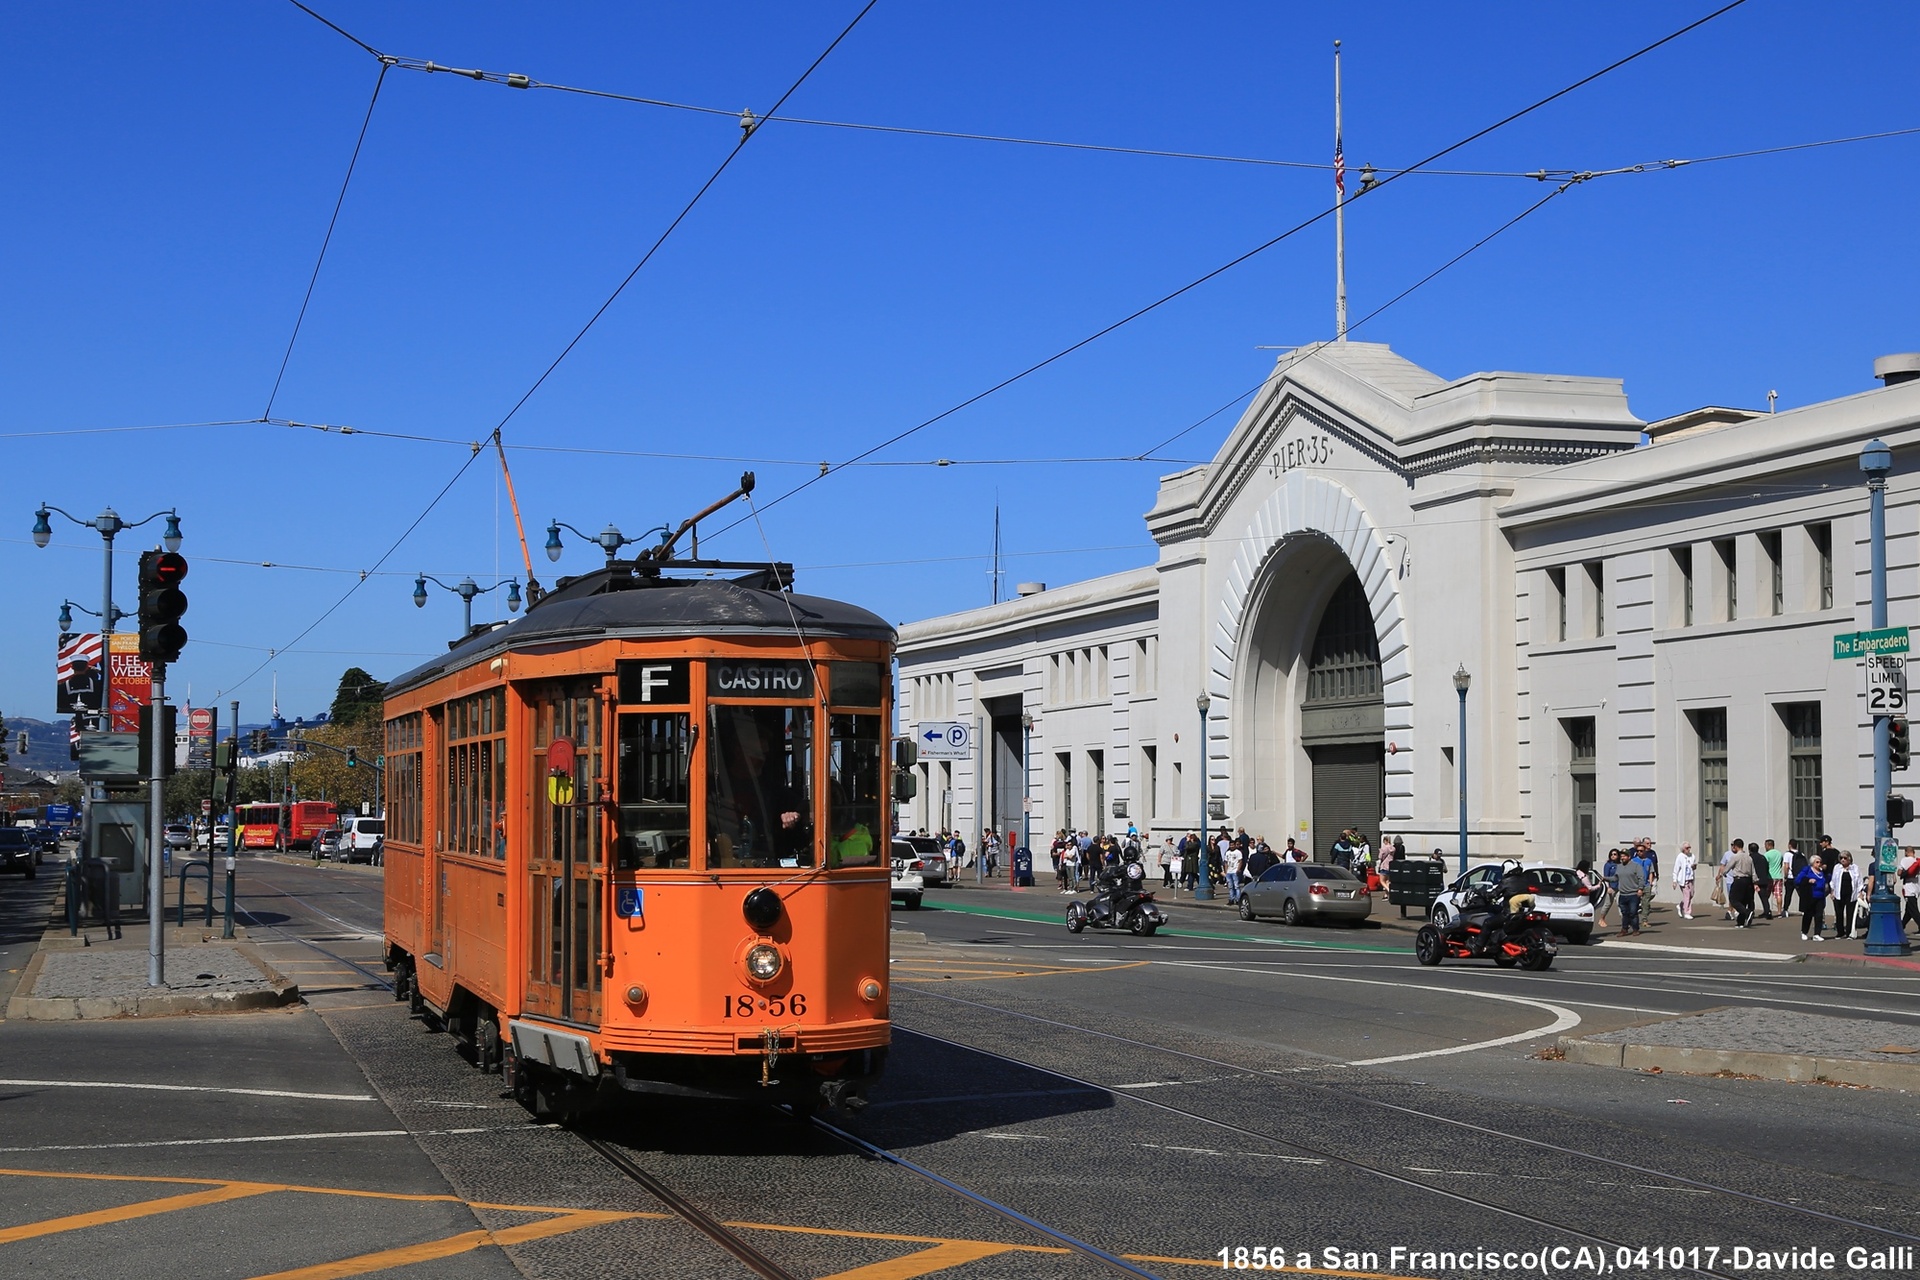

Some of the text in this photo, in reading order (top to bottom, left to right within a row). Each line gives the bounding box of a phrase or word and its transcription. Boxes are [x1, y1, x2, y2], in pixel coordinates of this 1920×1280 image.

[1272, 435, 1329, 480] PIER 35
[1835, 634, 1908, 654] The Embarcadero
[111, 655, 147, 667] FLEE
[1868, 657, 1904, 669] SPEED
[111, 666, 150, 677] WEEK
[111, 677, 151, 685] OCTOBER
[717, 666, 803, 691] CASTRO
[1871, 672, 1901, 684] LIMIT
[641, 665, 672, 702] F
[1870, 687, 1904, 709] 25
[723, 993, 807, 1018] 1856
